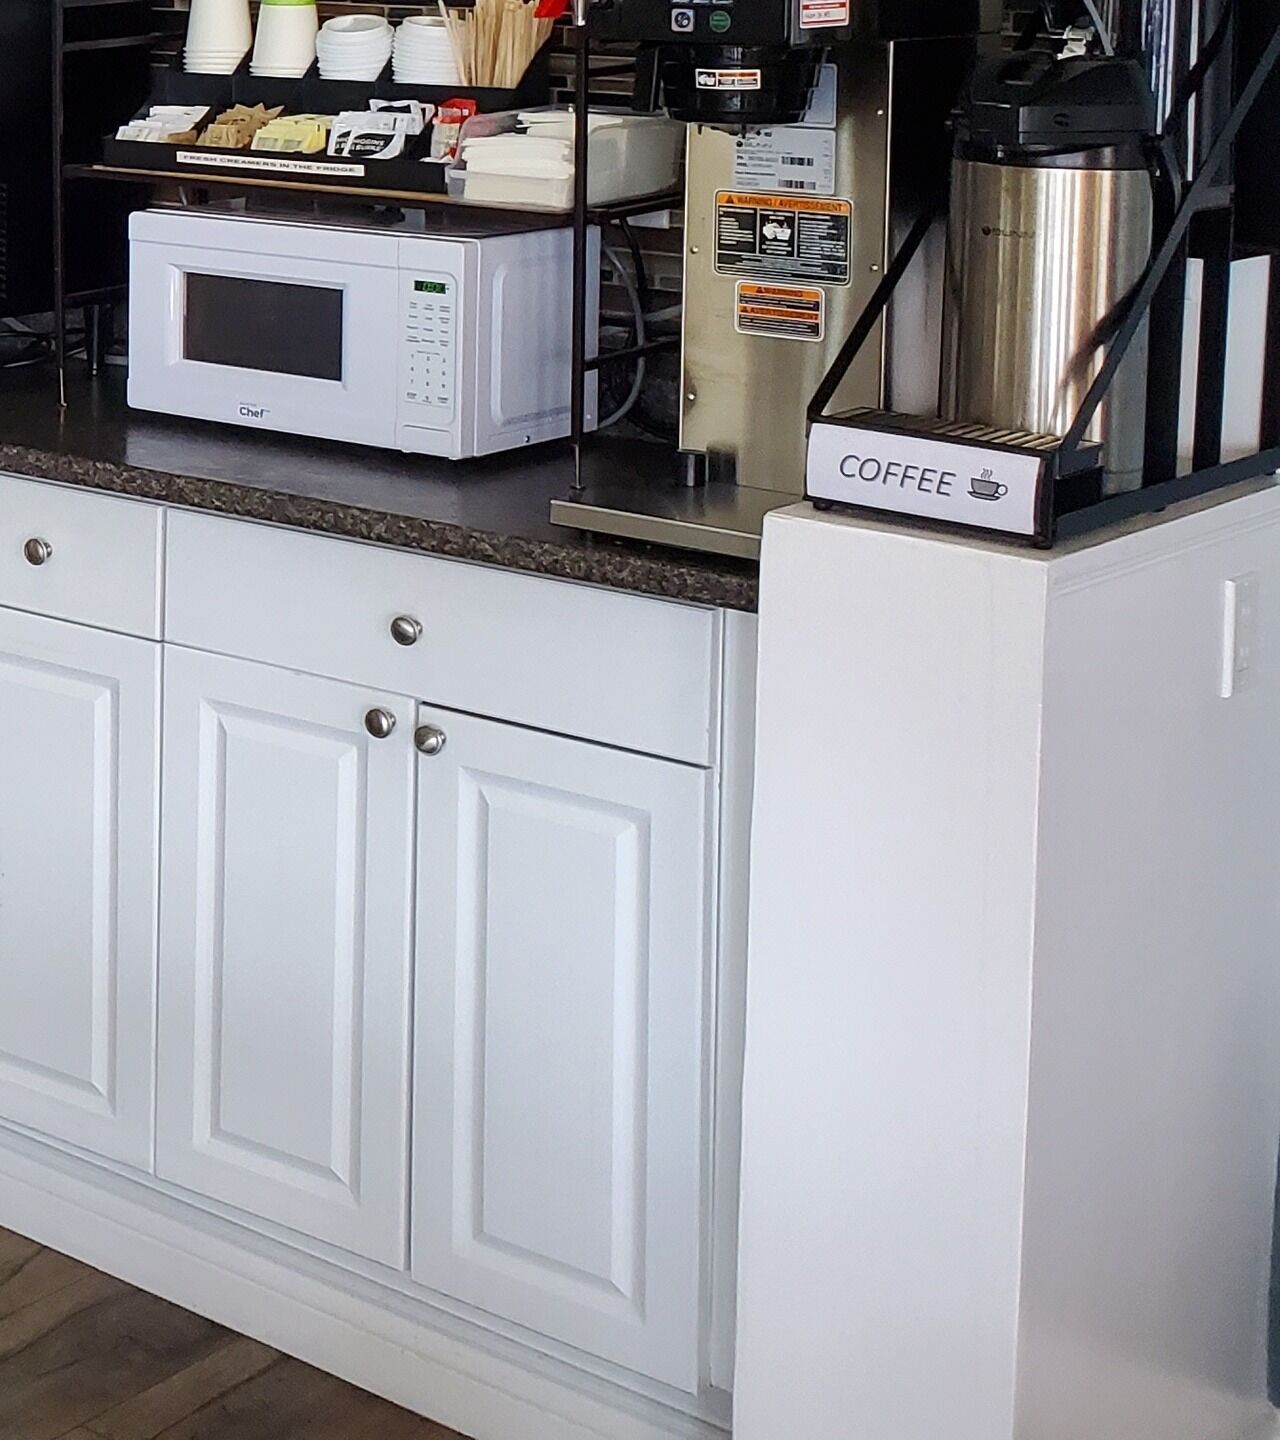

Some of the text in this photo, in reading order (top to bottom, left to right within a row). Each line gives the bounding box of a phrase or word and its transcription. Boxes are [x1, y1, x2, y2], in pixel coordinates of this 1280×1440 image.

[183, 154, 217, 163] FRESH
[219, 157, 277, 168] CREAMERS
[316, 165, 356, 173] FRIDGE
[239, 406, 265, 419] Chef
[839, 454, 957, 497] COFFEE
